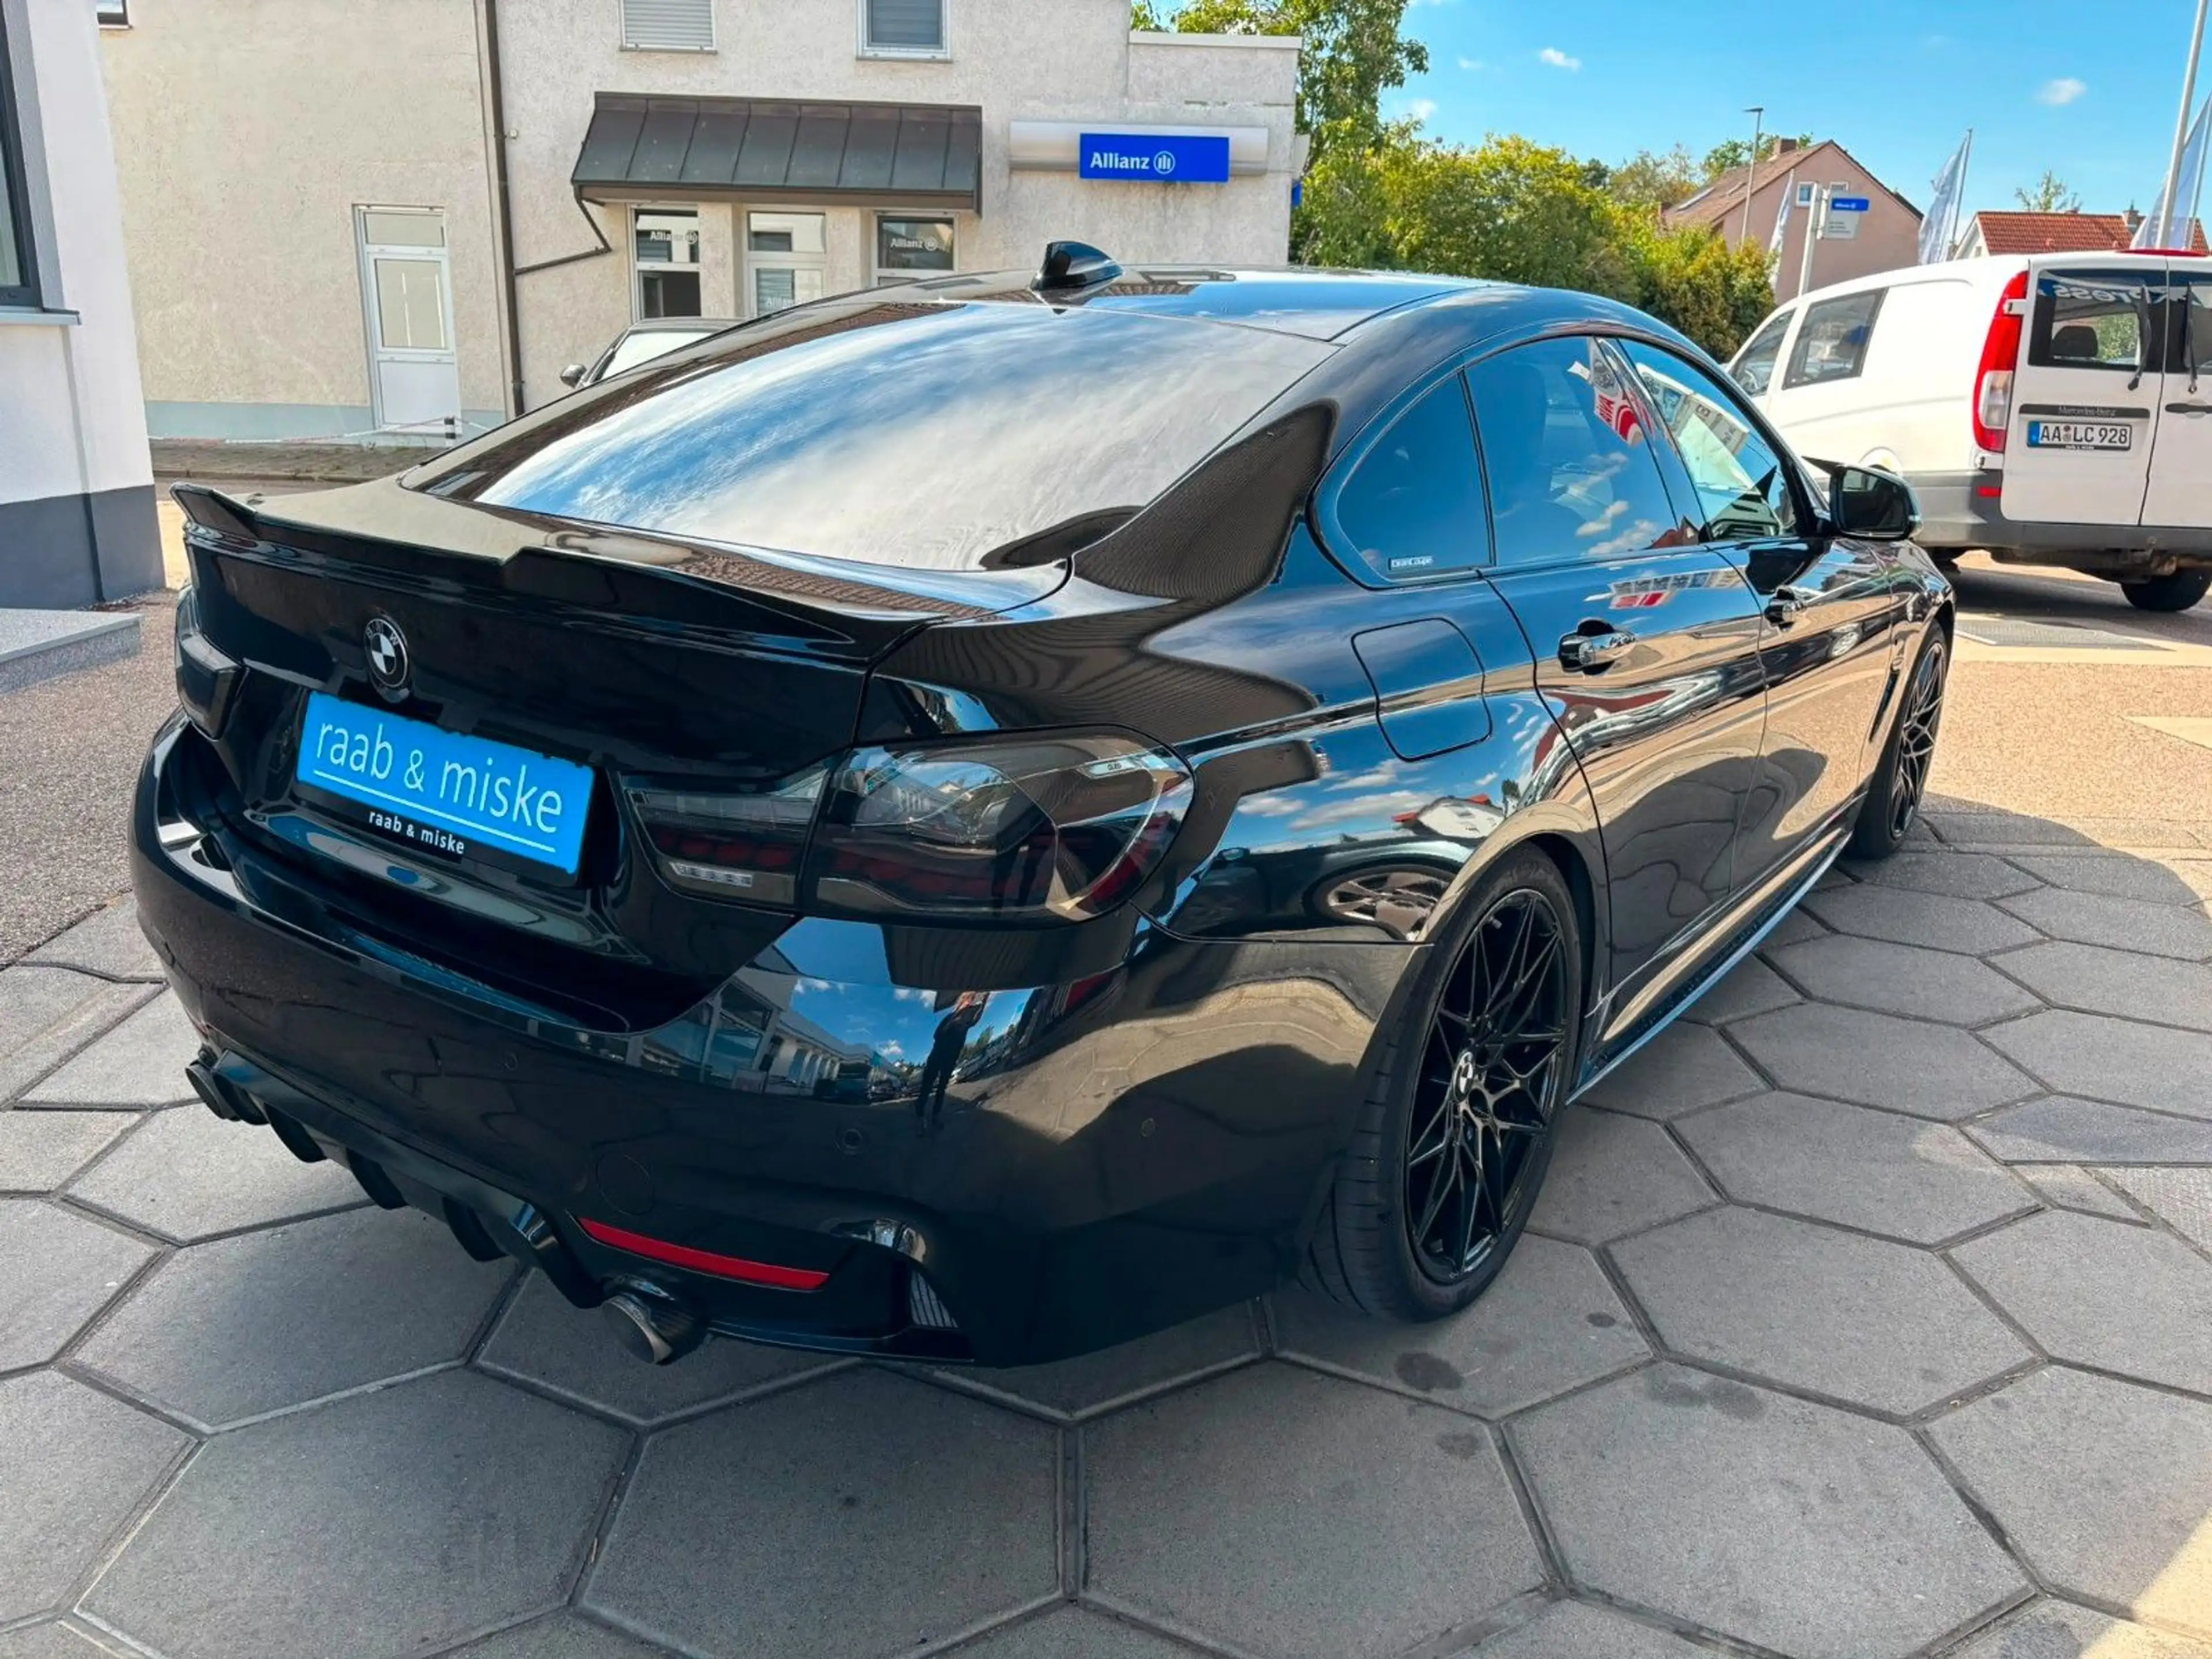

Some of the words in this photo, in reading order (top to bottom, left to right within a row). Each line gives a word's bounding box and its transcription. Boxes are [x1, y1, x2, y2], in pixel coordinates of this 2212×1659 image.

[1090, 151, 1150, 169] Allianz
[890, 237, 923, 249] Allianz
[2040, 425, 2061, 442] AA
[2073, 427, 2094, 443] LC
[2099, 428, 2127, 444] 928
[316, 722, 394, 780] raab
[403, 748, 425, 793] &
[440, 757, 562, 834] miske
[369, 810, 402, 834] raab
[406, 824, 415, 838] &
[421, 828, 465, 855] miske
